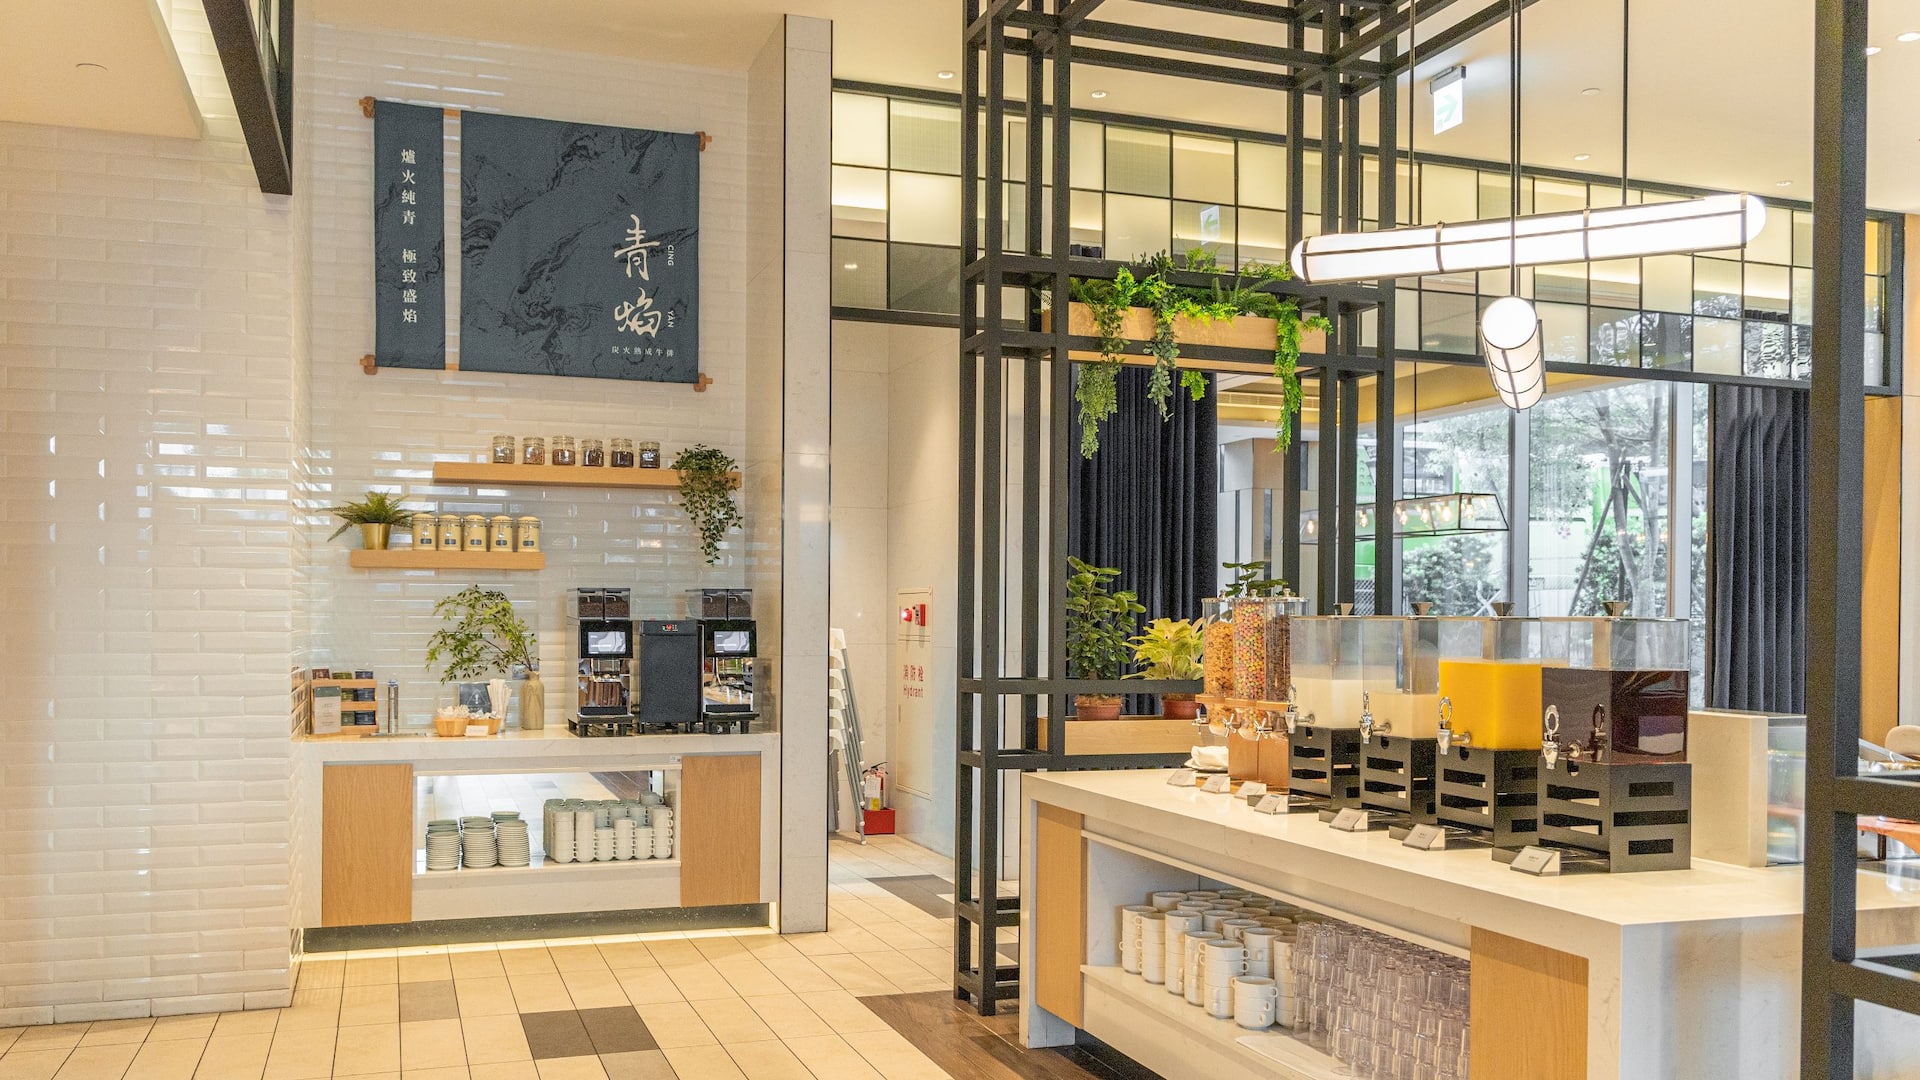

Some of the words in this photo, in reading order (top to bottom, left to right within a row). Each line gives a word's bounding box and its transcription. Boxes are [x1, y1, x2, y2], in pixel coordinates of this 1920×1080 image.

[401, 149, 416, 225] 爐火純青
[402, 248, 417, 323] 極致盛焰
[614, 214, 661, 338] 青焰
[667, 244, 675, 266] CING
[903, 684, 924, 699] Hydrant
